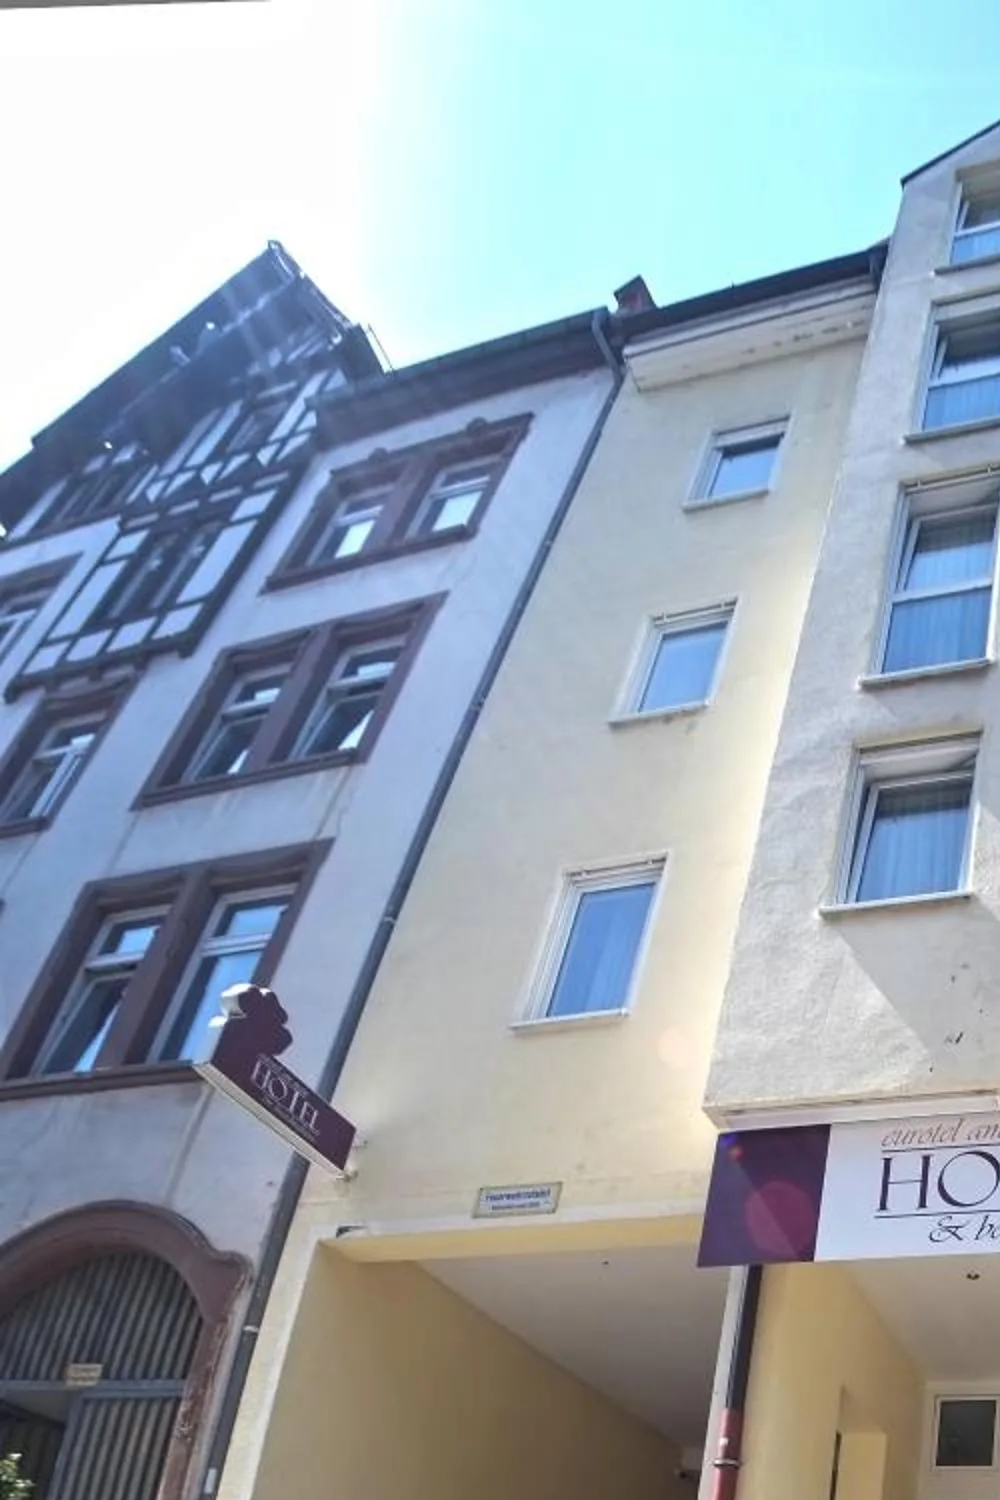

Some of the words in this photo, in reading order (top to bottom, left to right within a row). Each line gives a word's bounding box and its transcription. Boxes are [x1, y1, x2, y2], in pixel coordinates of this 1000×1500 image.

[251, 1058, 320, 1136] HOTEL
[881, 1118, 963, 1147] eurotel
[928, 1216, 970, 1243] &
